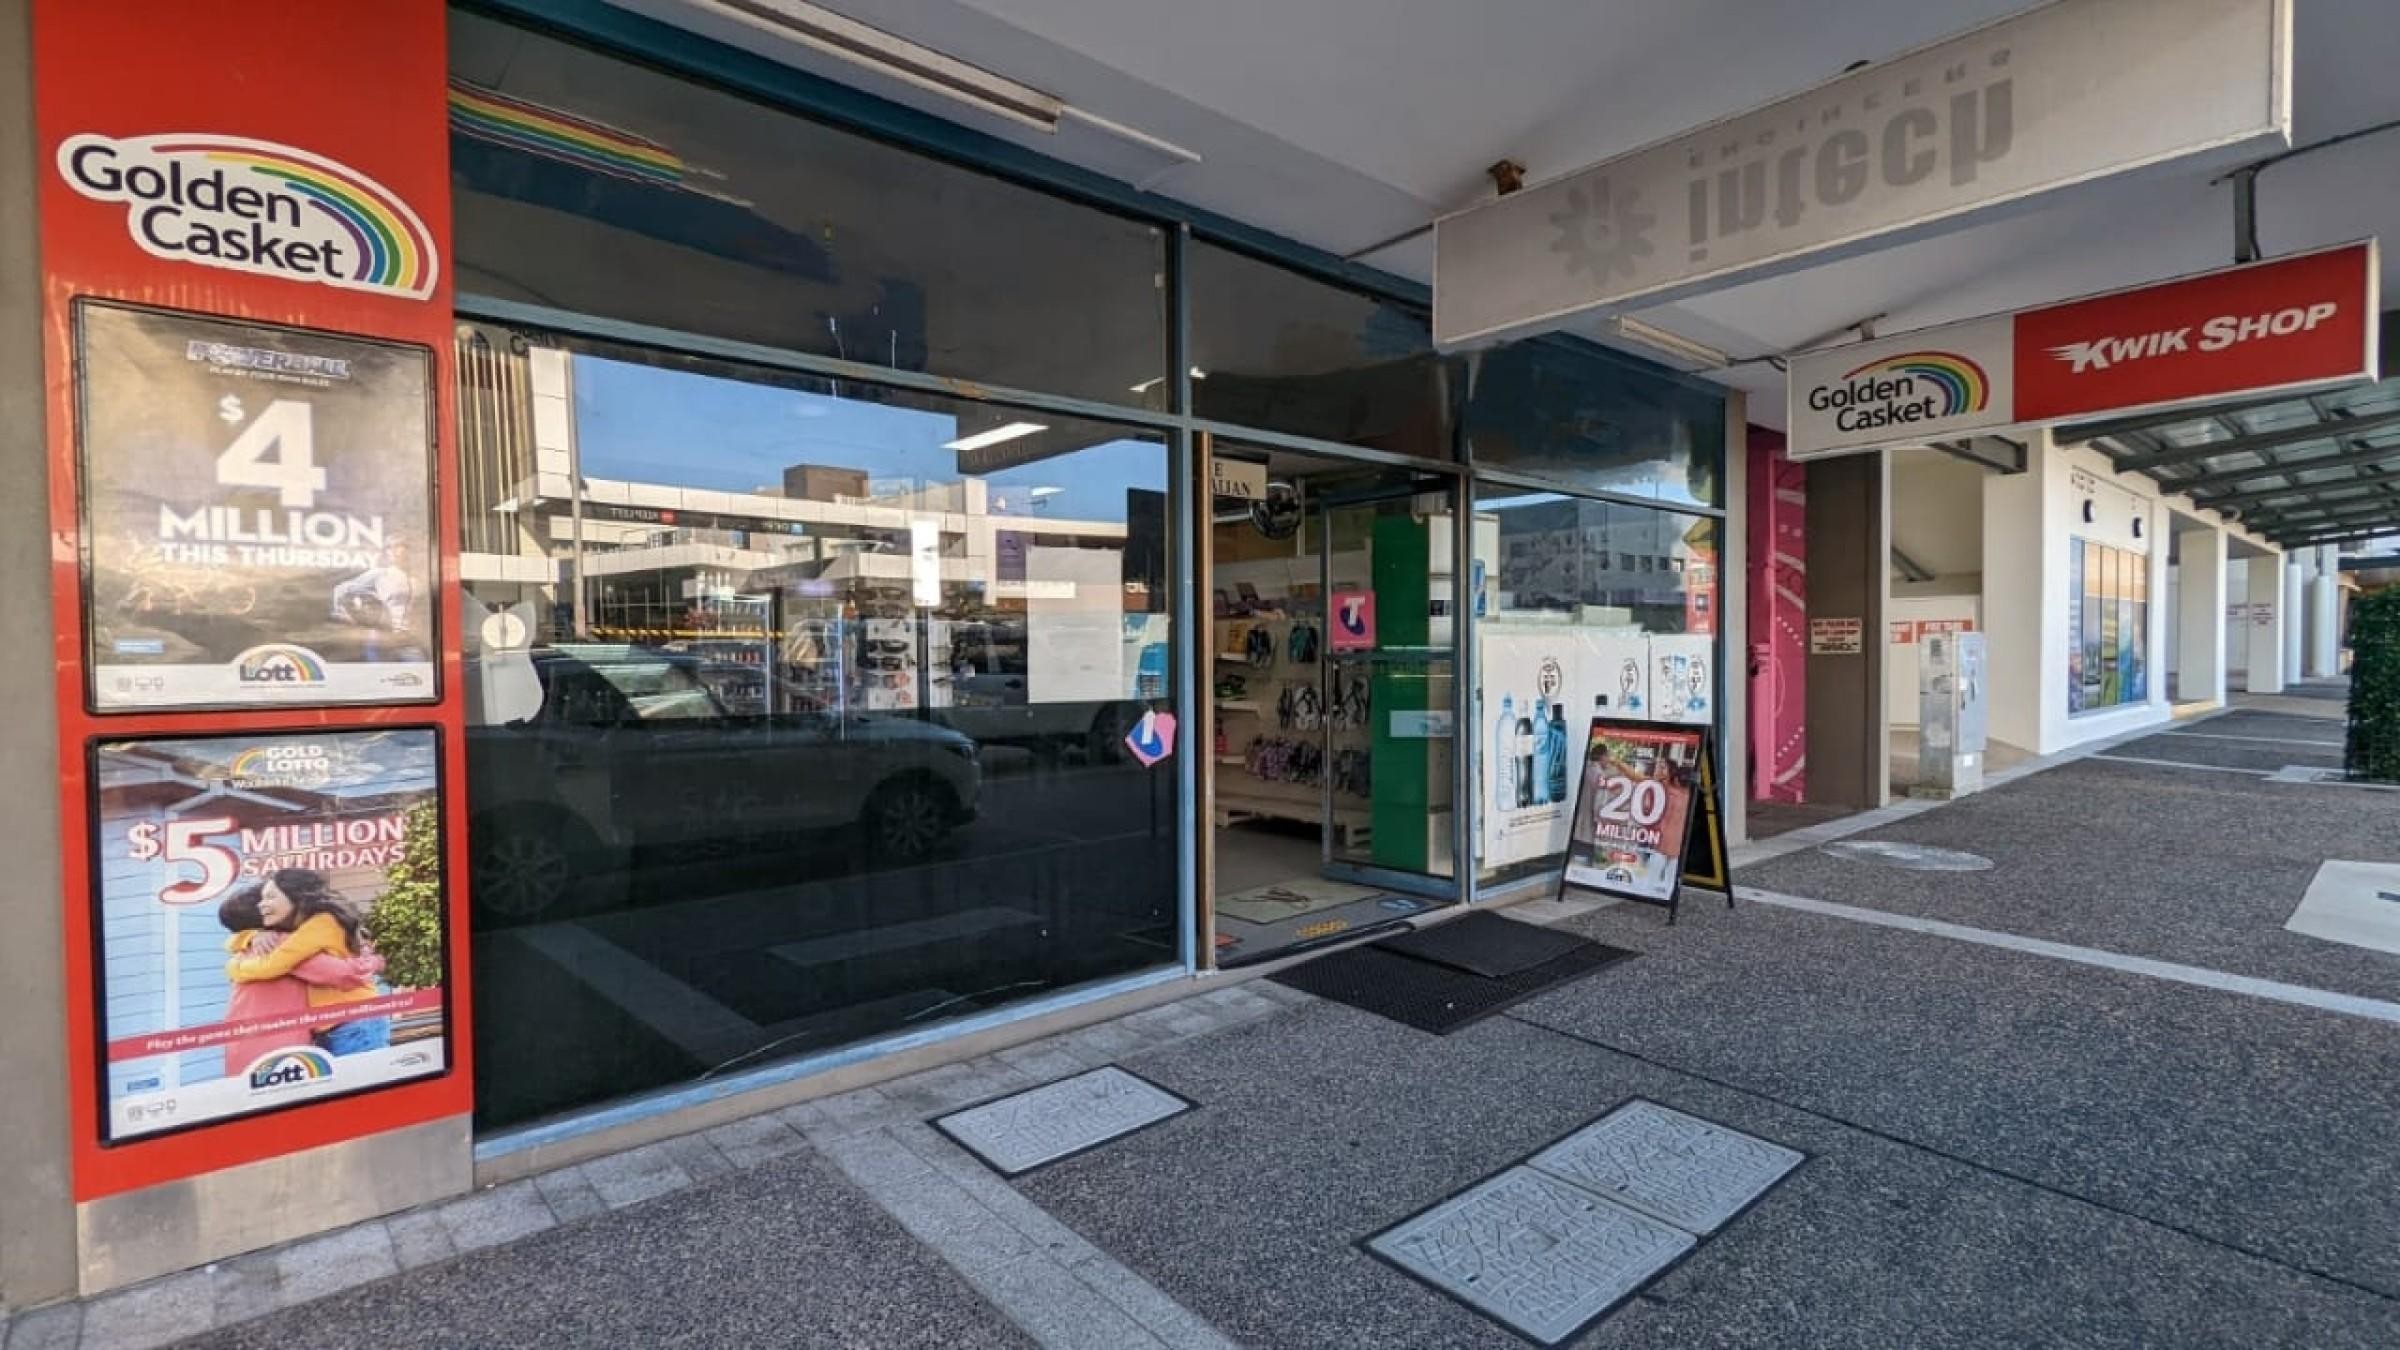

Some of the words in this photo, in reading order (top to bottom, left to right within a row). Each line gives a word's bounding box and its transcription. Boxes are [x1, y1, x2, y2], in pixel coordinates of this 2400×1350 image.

[70, 144, 301, 228] Golden
[141, 205, 344, 279] Casket
[2046, 327, 2191, 375] KWIK
[2198, 302, 2338, 353] SHOP
[1808, 374, 1914, 412] Golden
[1835, 396, 1936, 433] Casket
[160, 502, 384, 549] MILLION
[161, 543, 229, 565] THIS
[236, 545, 382, 569] THURSDAY
[239, 663, 296, 682] Lott
[265, 745, 323, 759] GOLD
[265, 758, 329, 773] LOTTO
[239, 815, 405, 855] MILLION
[1595, 823, 1662, 845] MILLION
[127, 815, 240, 904] $5
[242, 842, 407, 878] SATURDAYS
[250, 1064, 304, 1090] Lott
